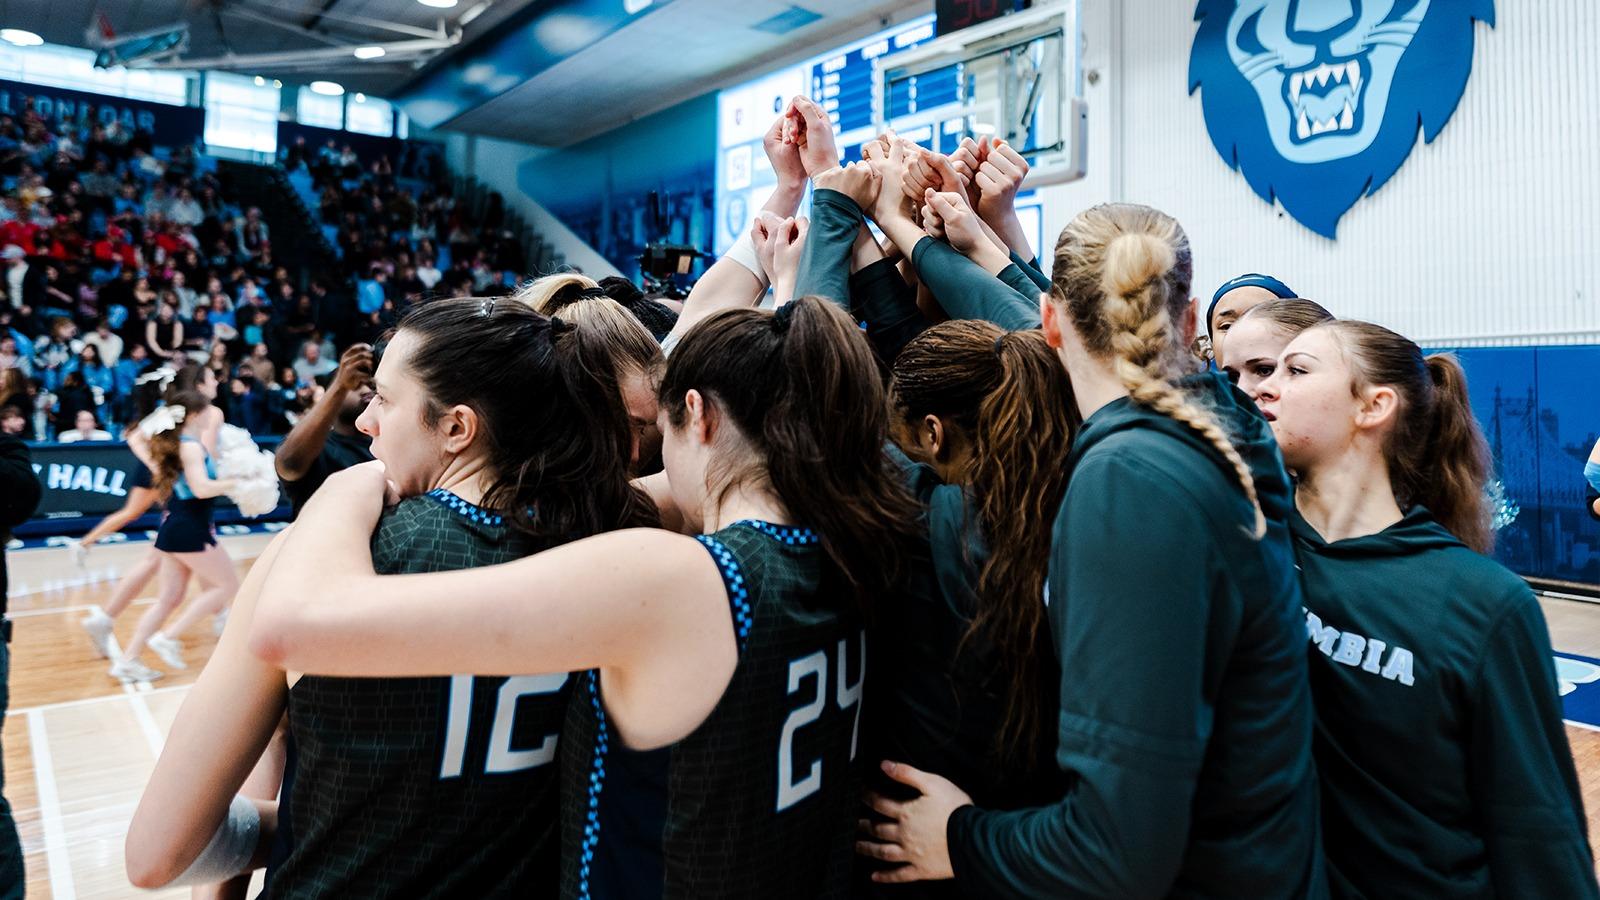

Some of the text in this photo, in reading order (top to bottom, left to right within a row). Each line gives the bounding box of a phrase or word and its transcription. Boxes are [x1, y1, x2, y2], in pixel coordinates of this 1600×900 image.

[47, 463, 127, 497] HALL
[1302, 606, 1415, 687] MBIA
[776, 630, 866, 812] 24
